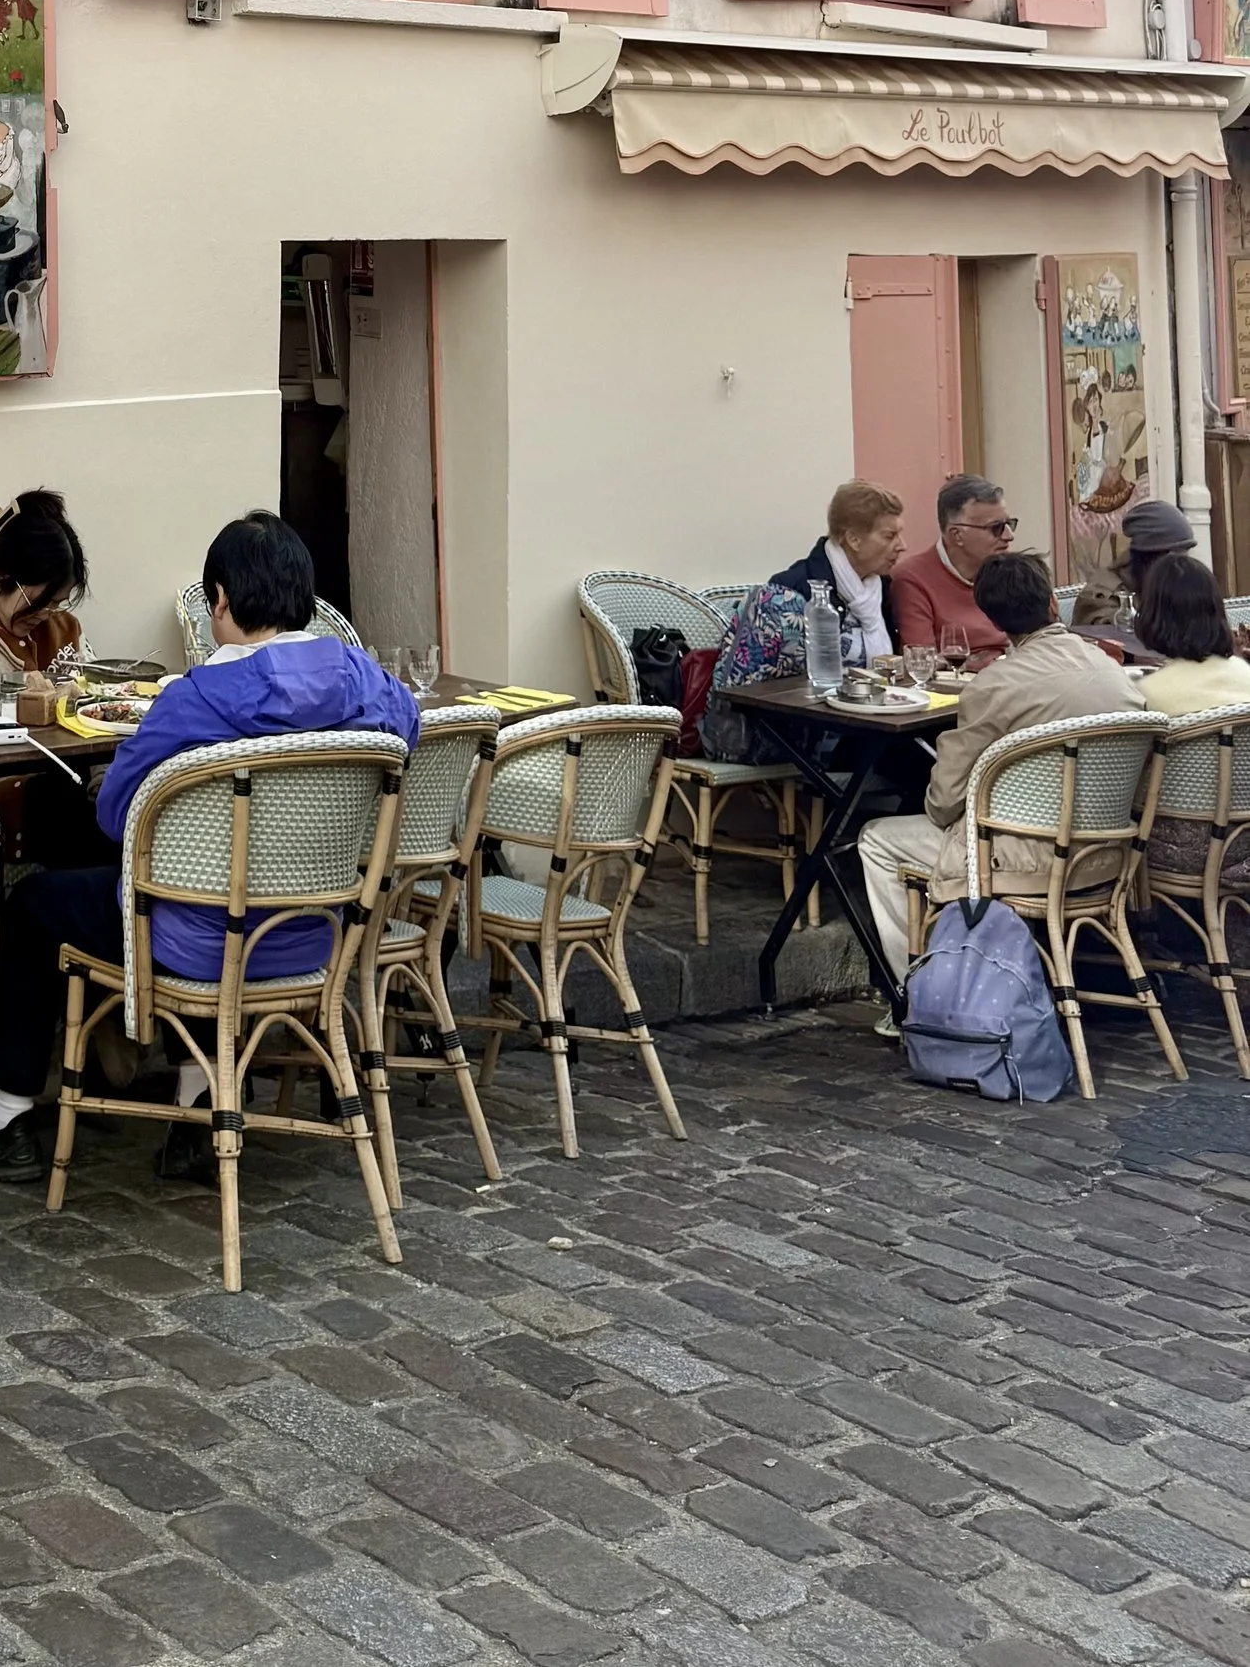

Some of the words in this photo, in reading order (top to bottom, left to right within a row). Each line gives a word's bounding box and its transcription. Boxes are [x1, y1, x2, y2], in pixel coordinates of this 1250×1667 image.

[902, 108, 930, 142] Le
[936, 107, 1004, 146] Poulbot
[41, 642, 74, 674] onder
